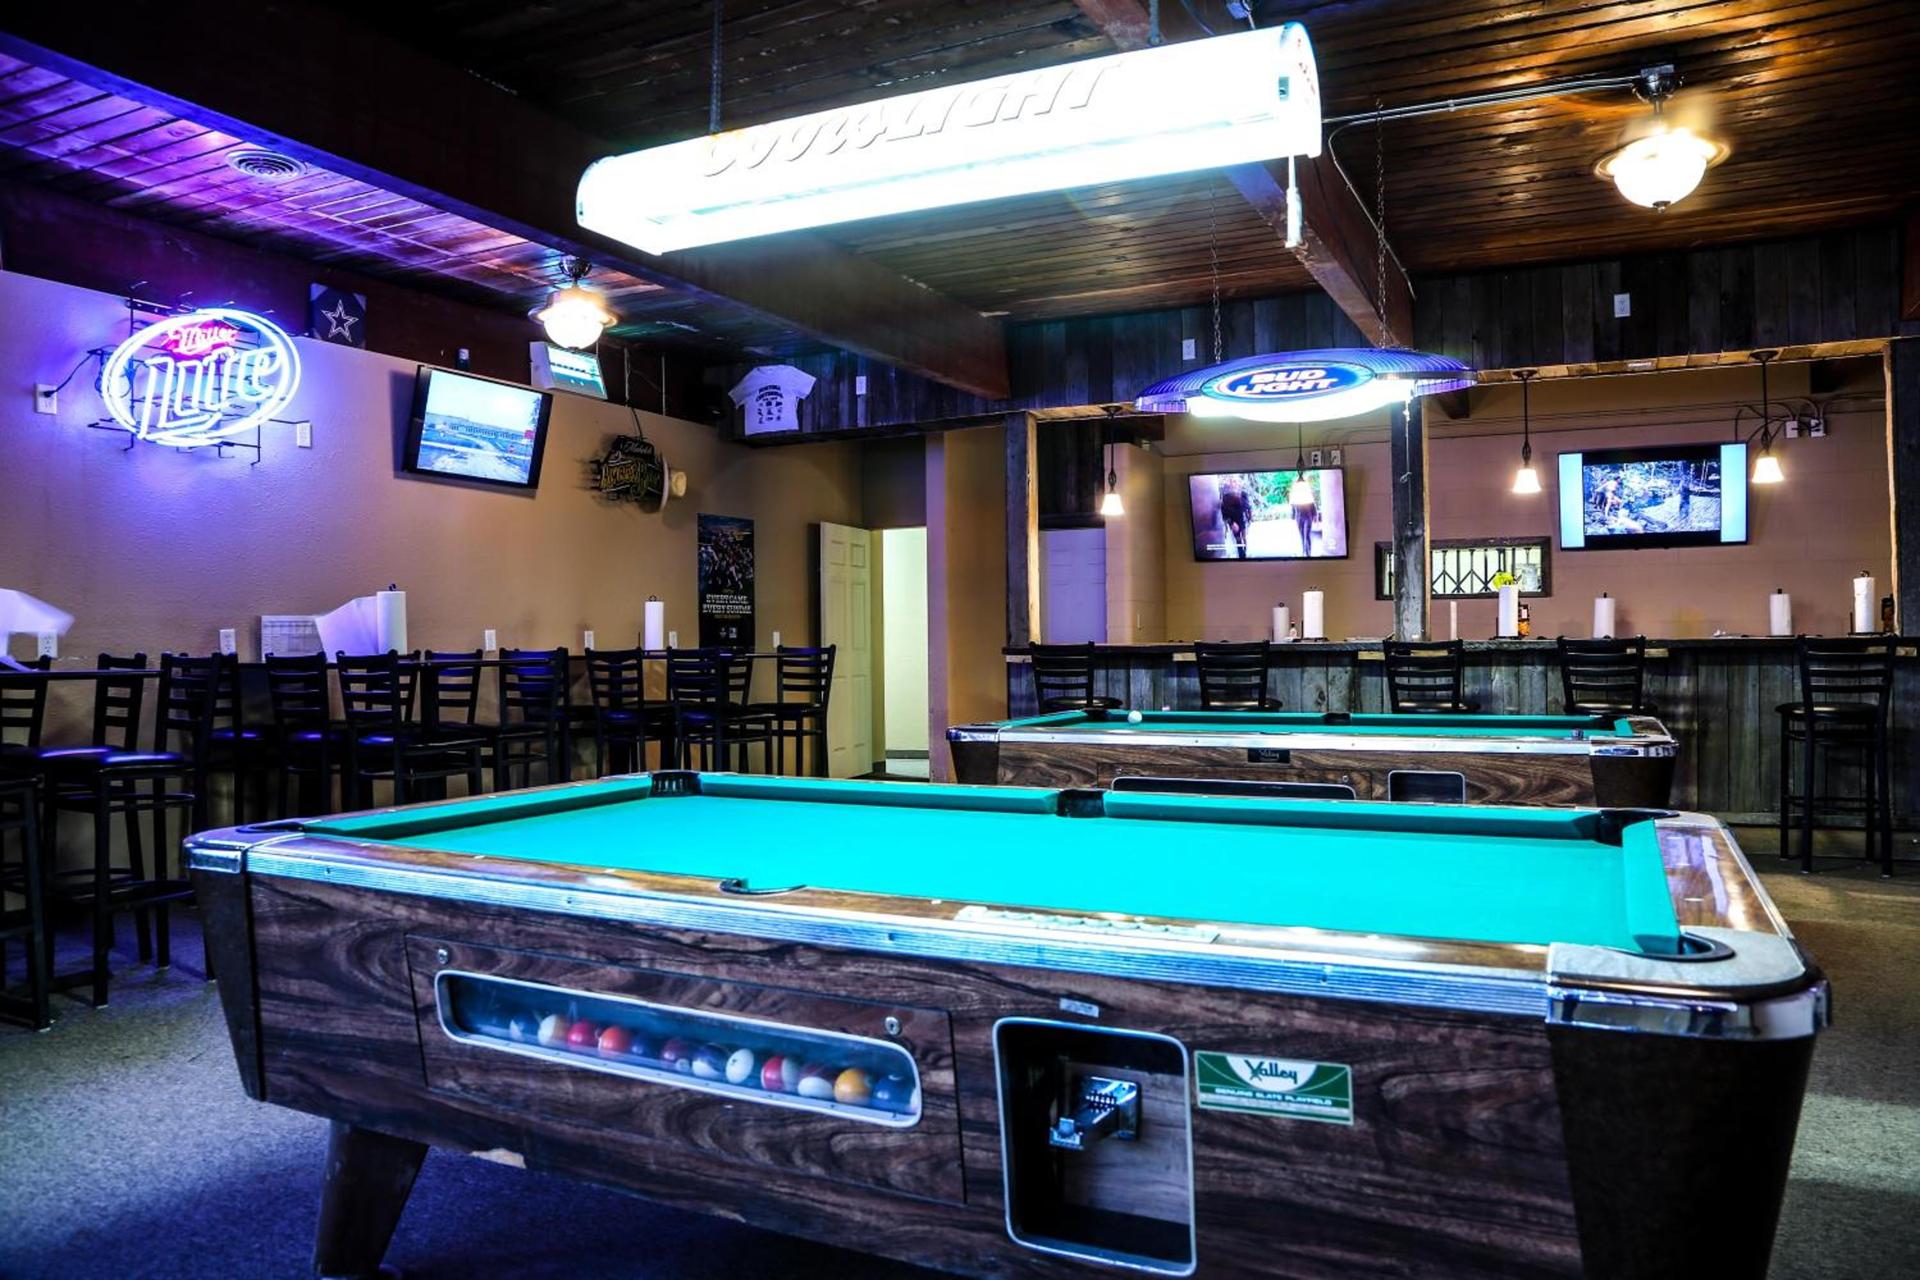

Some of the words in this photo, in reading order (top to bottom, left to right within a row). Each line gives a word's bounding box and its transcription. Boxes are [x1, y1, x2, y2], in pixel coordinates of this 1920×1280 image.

[1250, 369, 1328, 384] BUD
[138, 346, 281, 440] Lite
[1234, 378, 1339, 395] LIGHT
[1244, 1059, 1298, 1085] Valley
[1215, 1087, 1253, 1098] GENUINE
[1255, 1091, 1282, 1101] SLATE
[1285, 1094, 1332, 1106] PLAYFIELD
